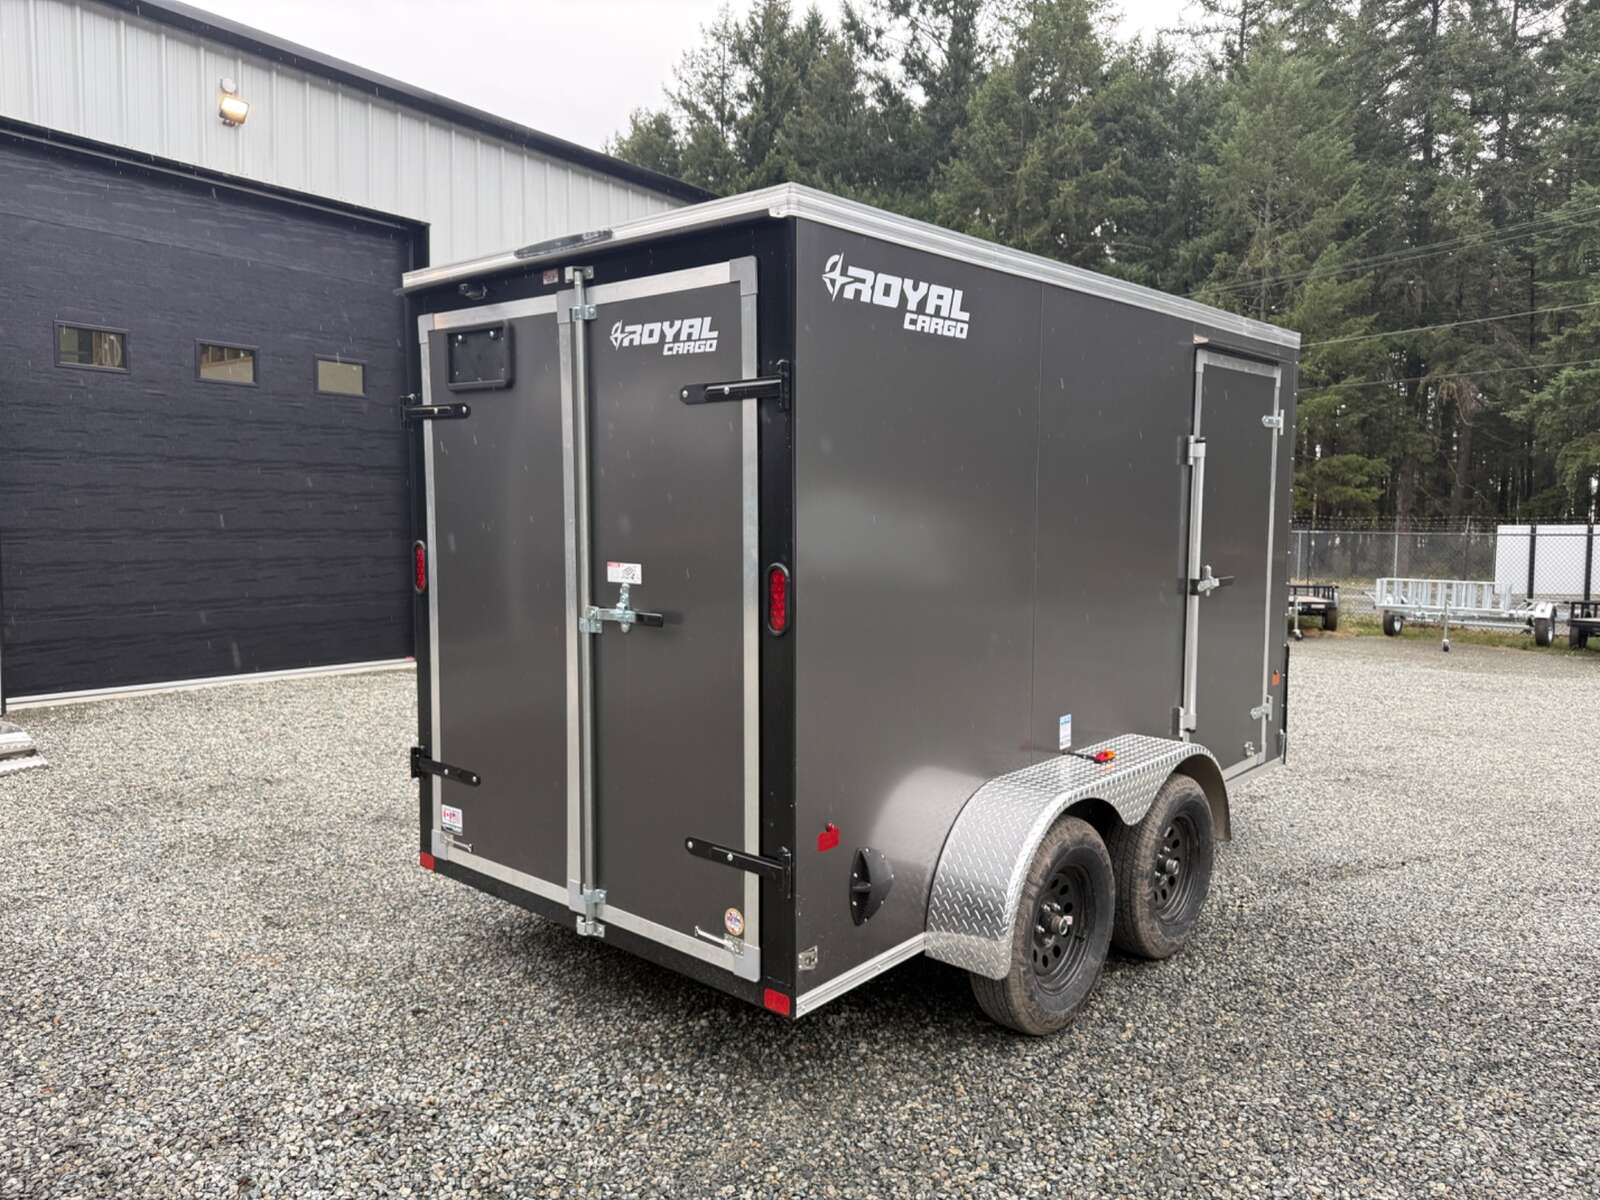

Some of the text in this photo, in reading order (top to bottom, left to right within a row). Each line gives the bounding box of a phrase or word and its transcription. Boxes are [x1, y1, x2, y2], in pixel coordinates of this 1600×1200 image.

[843, 265, 970, 321] ROYAL
[622, 316, 719, 347] ROYAL
[903, 312, 969, 339] CARGO
[663, 340, 718, 355] CARGO
